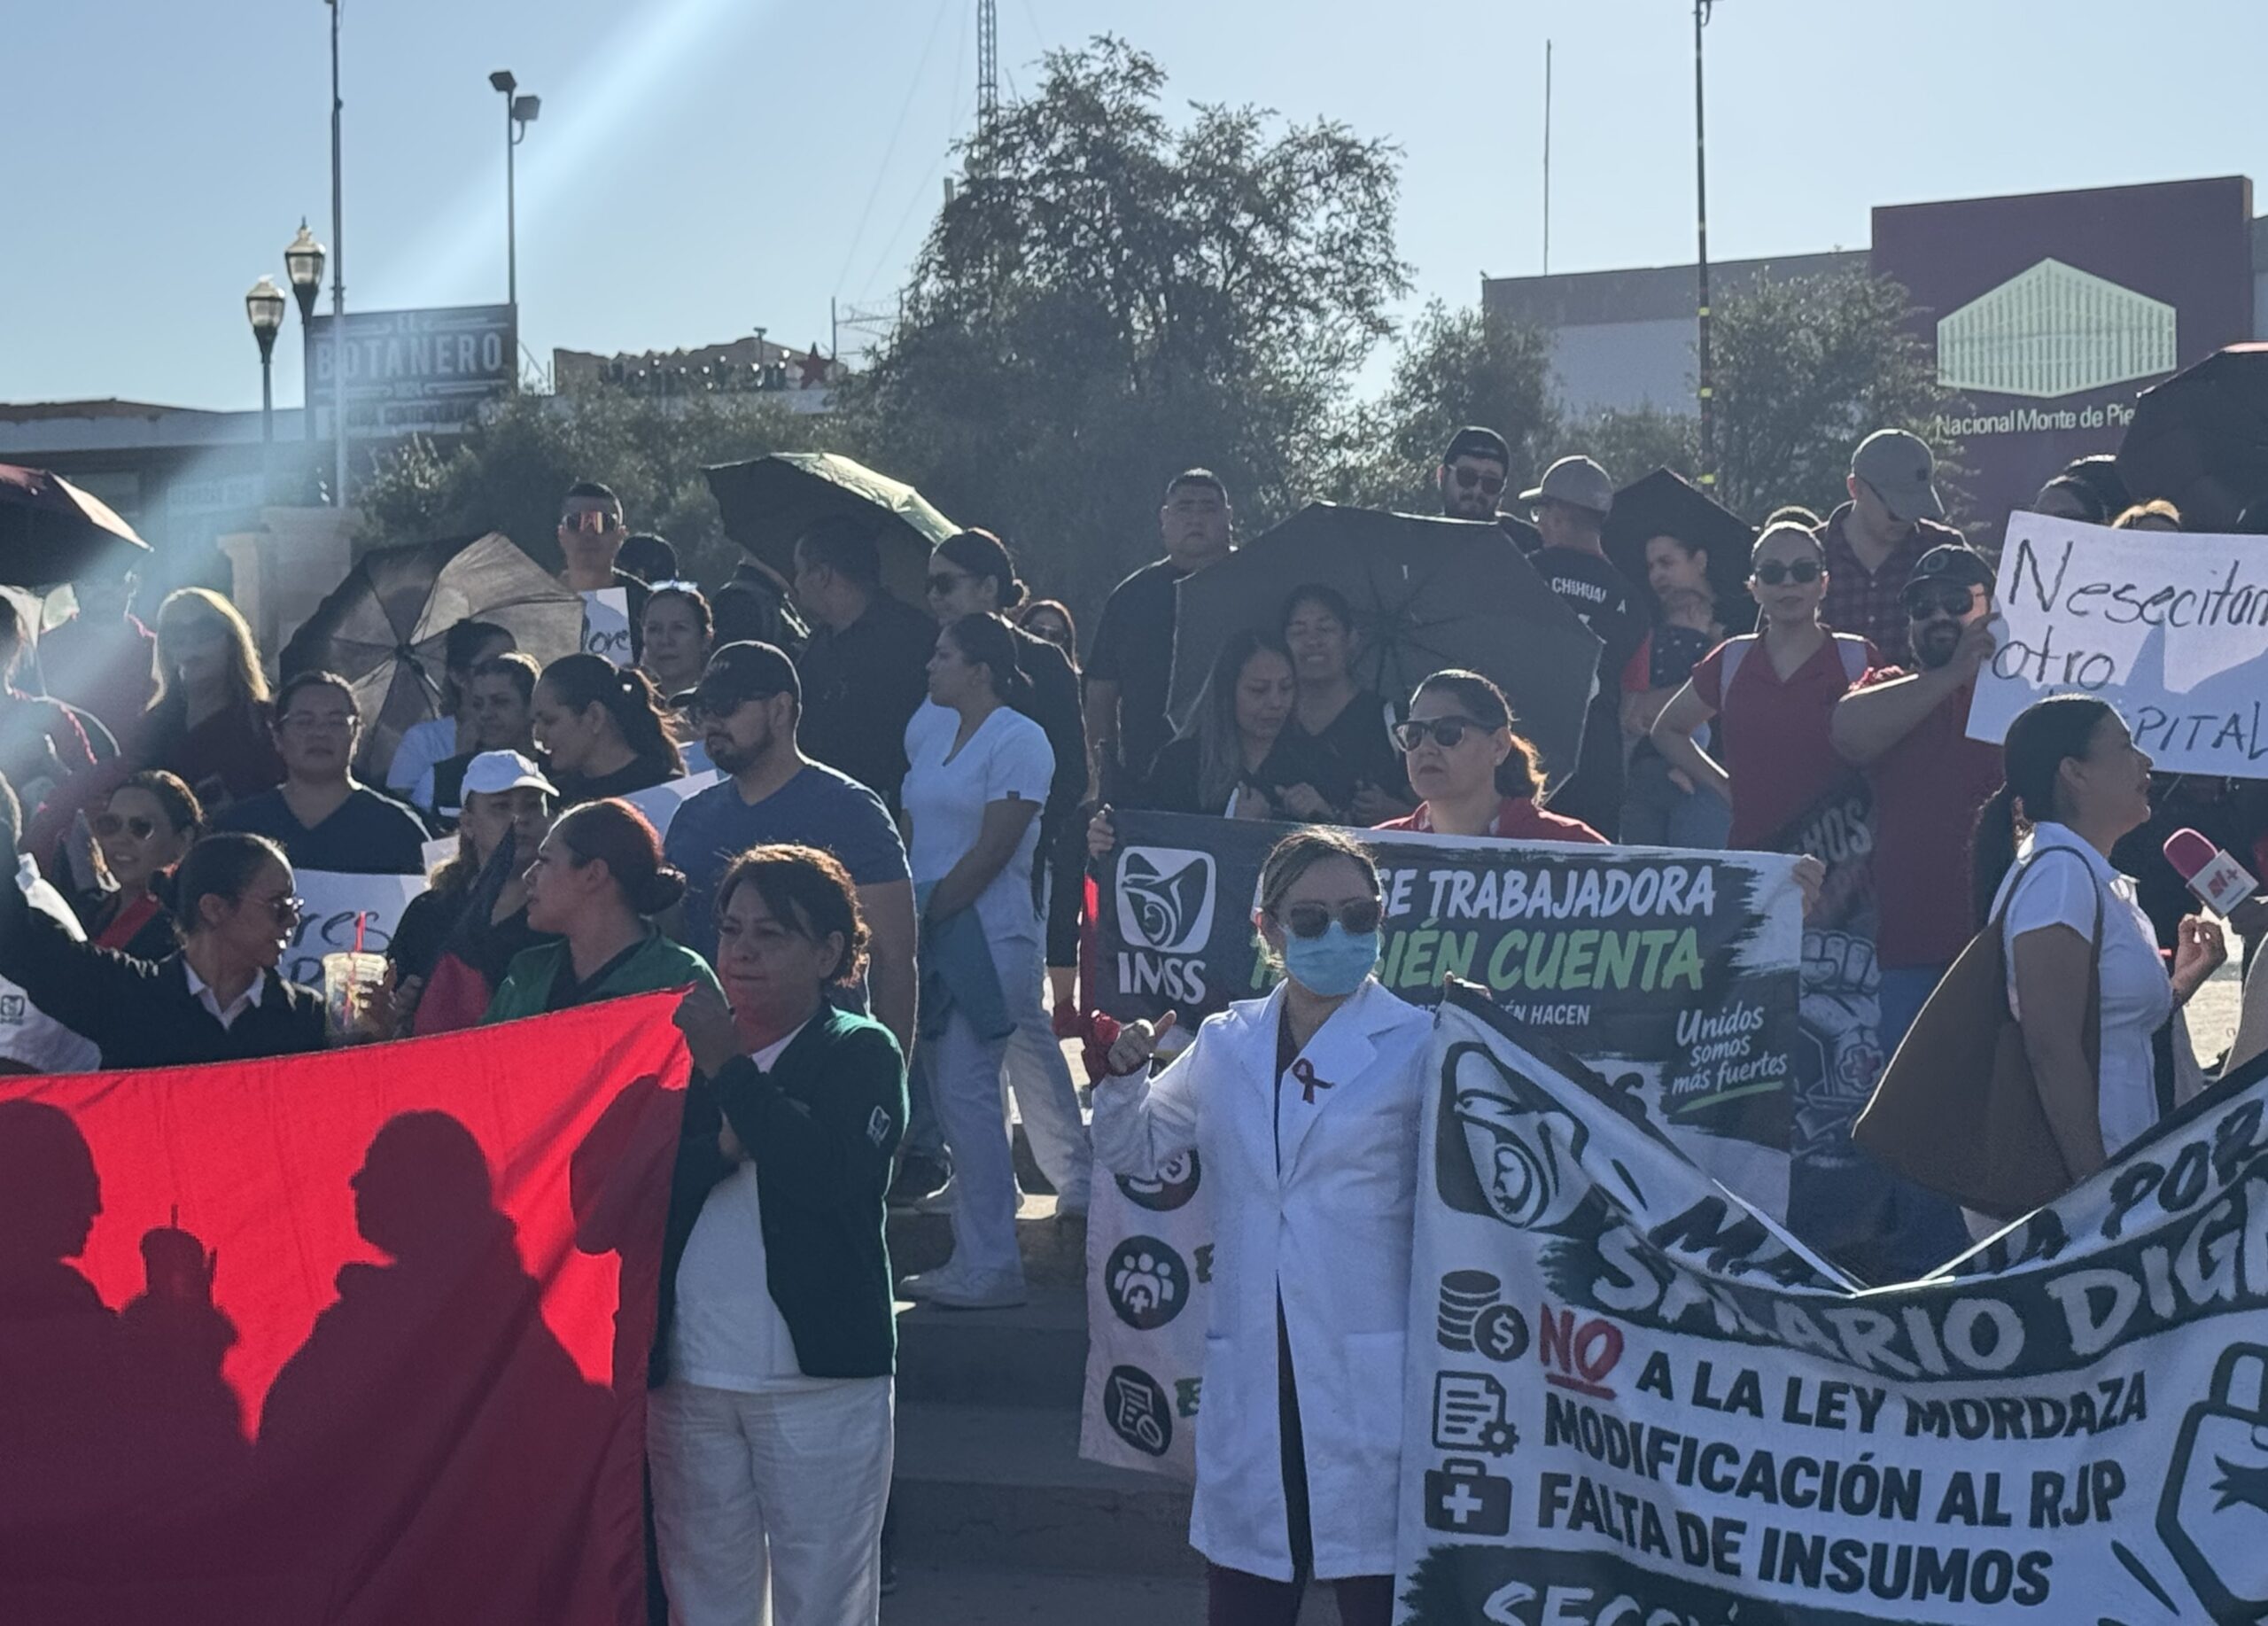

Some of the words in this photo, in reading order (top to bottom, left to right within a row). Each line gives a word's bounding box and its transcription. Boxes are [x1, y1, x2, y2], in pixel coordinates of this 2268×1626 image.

[315, 331, 502, 380] BOTANERO
[1938, 409, 2016, 437] Nacional
[2017, 408, 2077, 432] Monte
[2080, 405, 2104, 428] de
[2107, 403, 2136, 427] Pie
[1428, 865, 1717, 921] TRABAJADORA
[1117, 952, 1207, 1005] IMSS
[1487, 926, 1705, 992] CUENTA
[1529, 1004, 1591, 1026] HACEN
[1676, 1000, 1765, 1046] Unidos
[1671, 1067, 1711, 1095] más
[1716, 1051, 1788, 1092] fuertes
[1690, 1035, 1751, 1067] somos
[1539, 1302, 1625, 1382] NO
[1635, 1350, 1674, 1402] A
[1690, 1359, 1765, 1420] LA
[1782, 1375, 1887, 1434] LEY
[1904, 1370, 2148, 1441] MORDAZA
[1543, 1390, 1923, 1523] MODIFICACIÓN
[1935, 1470, 2013, 1528] AL
[2029, 1459, 2127, 1529] RJP
[1537, 1471, 1674, 1560] FALTA
[1674, 1509, 1748, 1577] DE
[1757, 1526, 2054, 1607] INSUMOS
